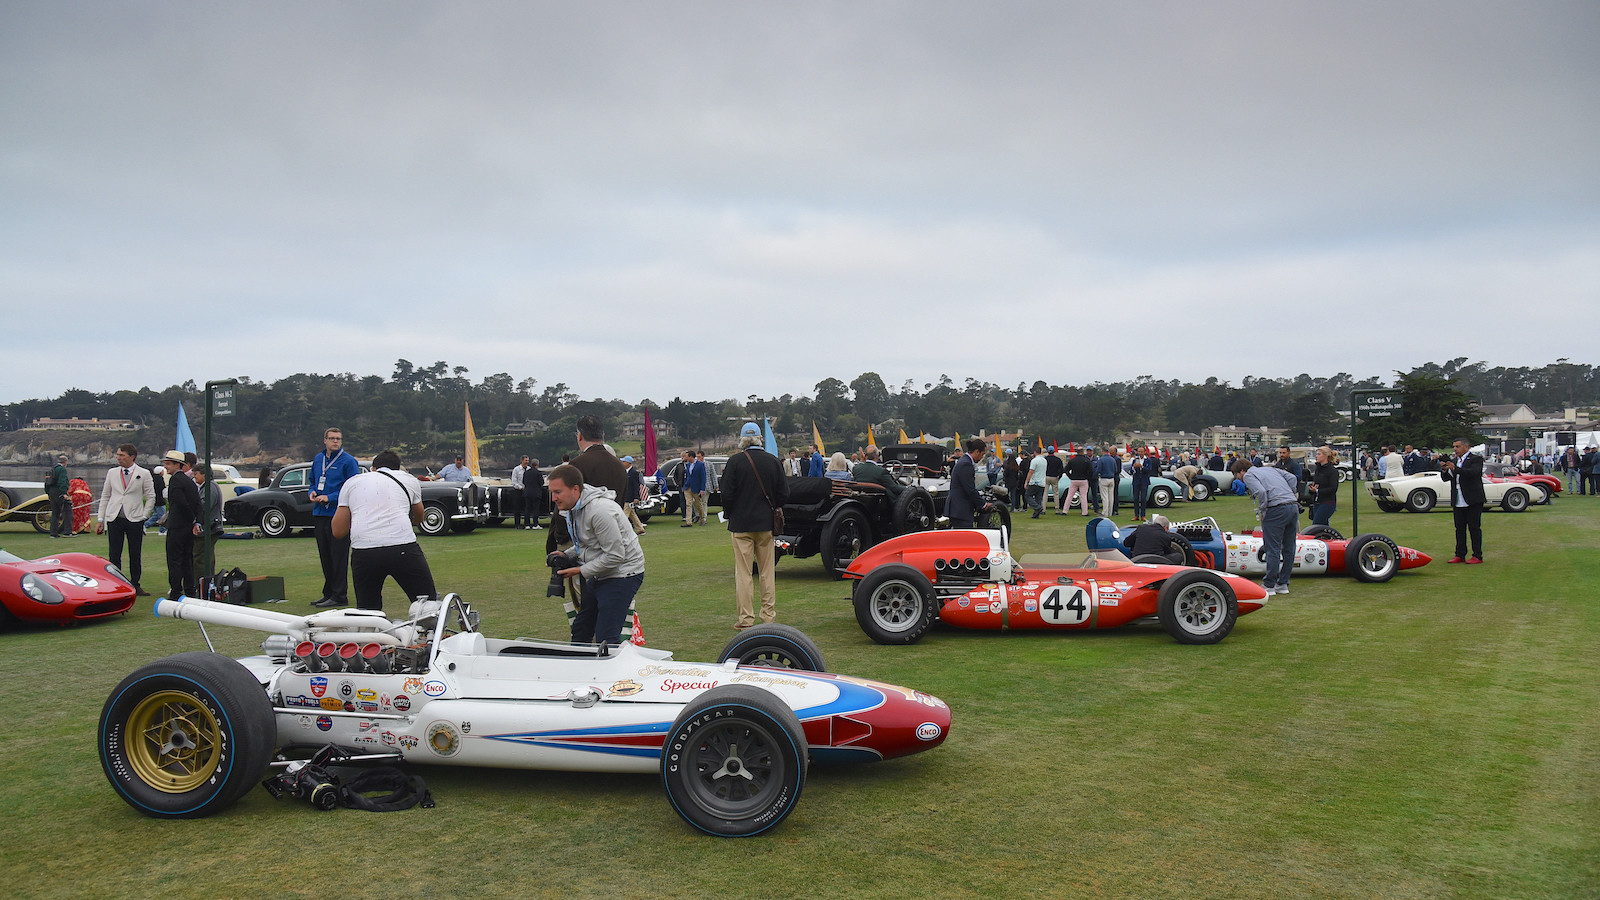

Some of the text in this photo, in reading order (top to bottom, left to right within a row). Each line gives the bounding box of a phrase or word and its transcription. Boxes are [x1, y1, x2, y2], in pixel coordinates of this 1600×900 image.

[1042, 589, 1086, 620] 44
[660, 678, 719, 693] Special
[730, 672, 808, 689] Thompson
[193, 691, 227, 785] GOODYEAR
[400, 739, 418, 747] BEAR
[670, 709, 734, 772] GOODYEAR
